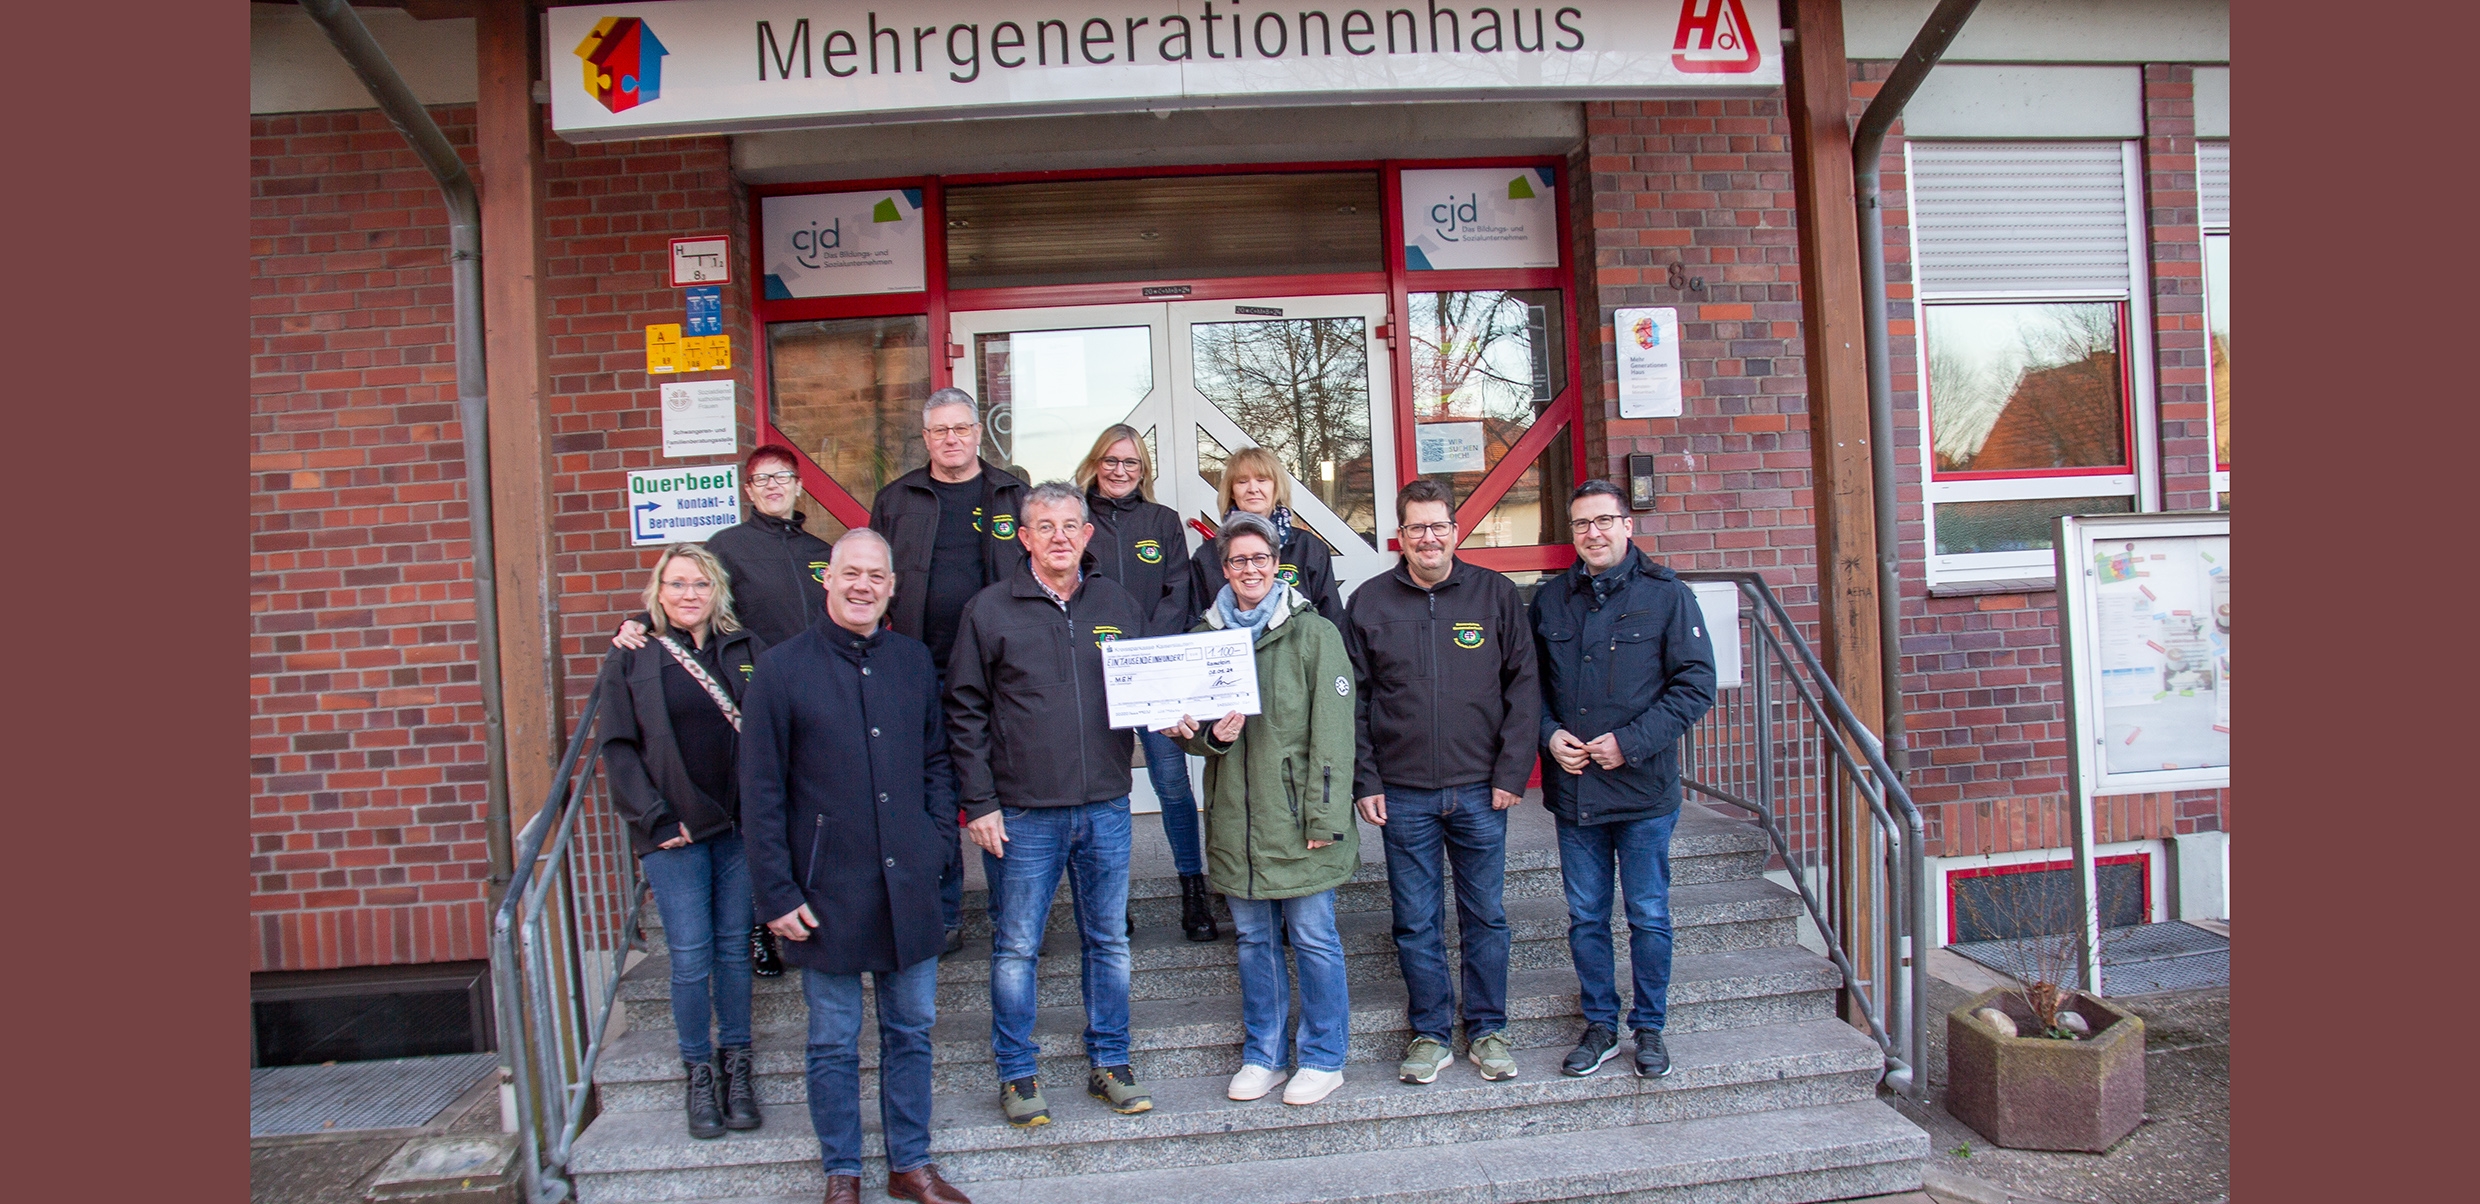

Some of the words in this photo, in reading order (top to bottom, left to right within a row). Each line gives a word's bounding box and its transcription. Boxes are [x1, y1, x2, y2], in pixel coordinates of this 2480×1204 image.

[755, 0, 1585, 84] Mehrgenerationenhaus
[1431, 193, 1477, 232] cjd
[1477, 225, 1509, 233] Bildungs-
[792, 217, 840, 258] cjd
[1462, 234, 1528, 242] Sozialunternehmen
[675, 245, 684, 255] H
[839, 251, 872, 259] Bildungs-
[824, 259, 892, 268] Sozialunternehmen
[657, 331, 665, 342] A
[697, 388, 732, 396] Sozialdienst
[632, 470, 733, 495] Querbeet
[677, 496, 725, 510] Kontakt-
[728, 494, 736, 507] &
[649, 513, 736, 529] Beratungsstelle
[1106, 653, 1185, 667] EINTAUSENDEINHUNDERT
